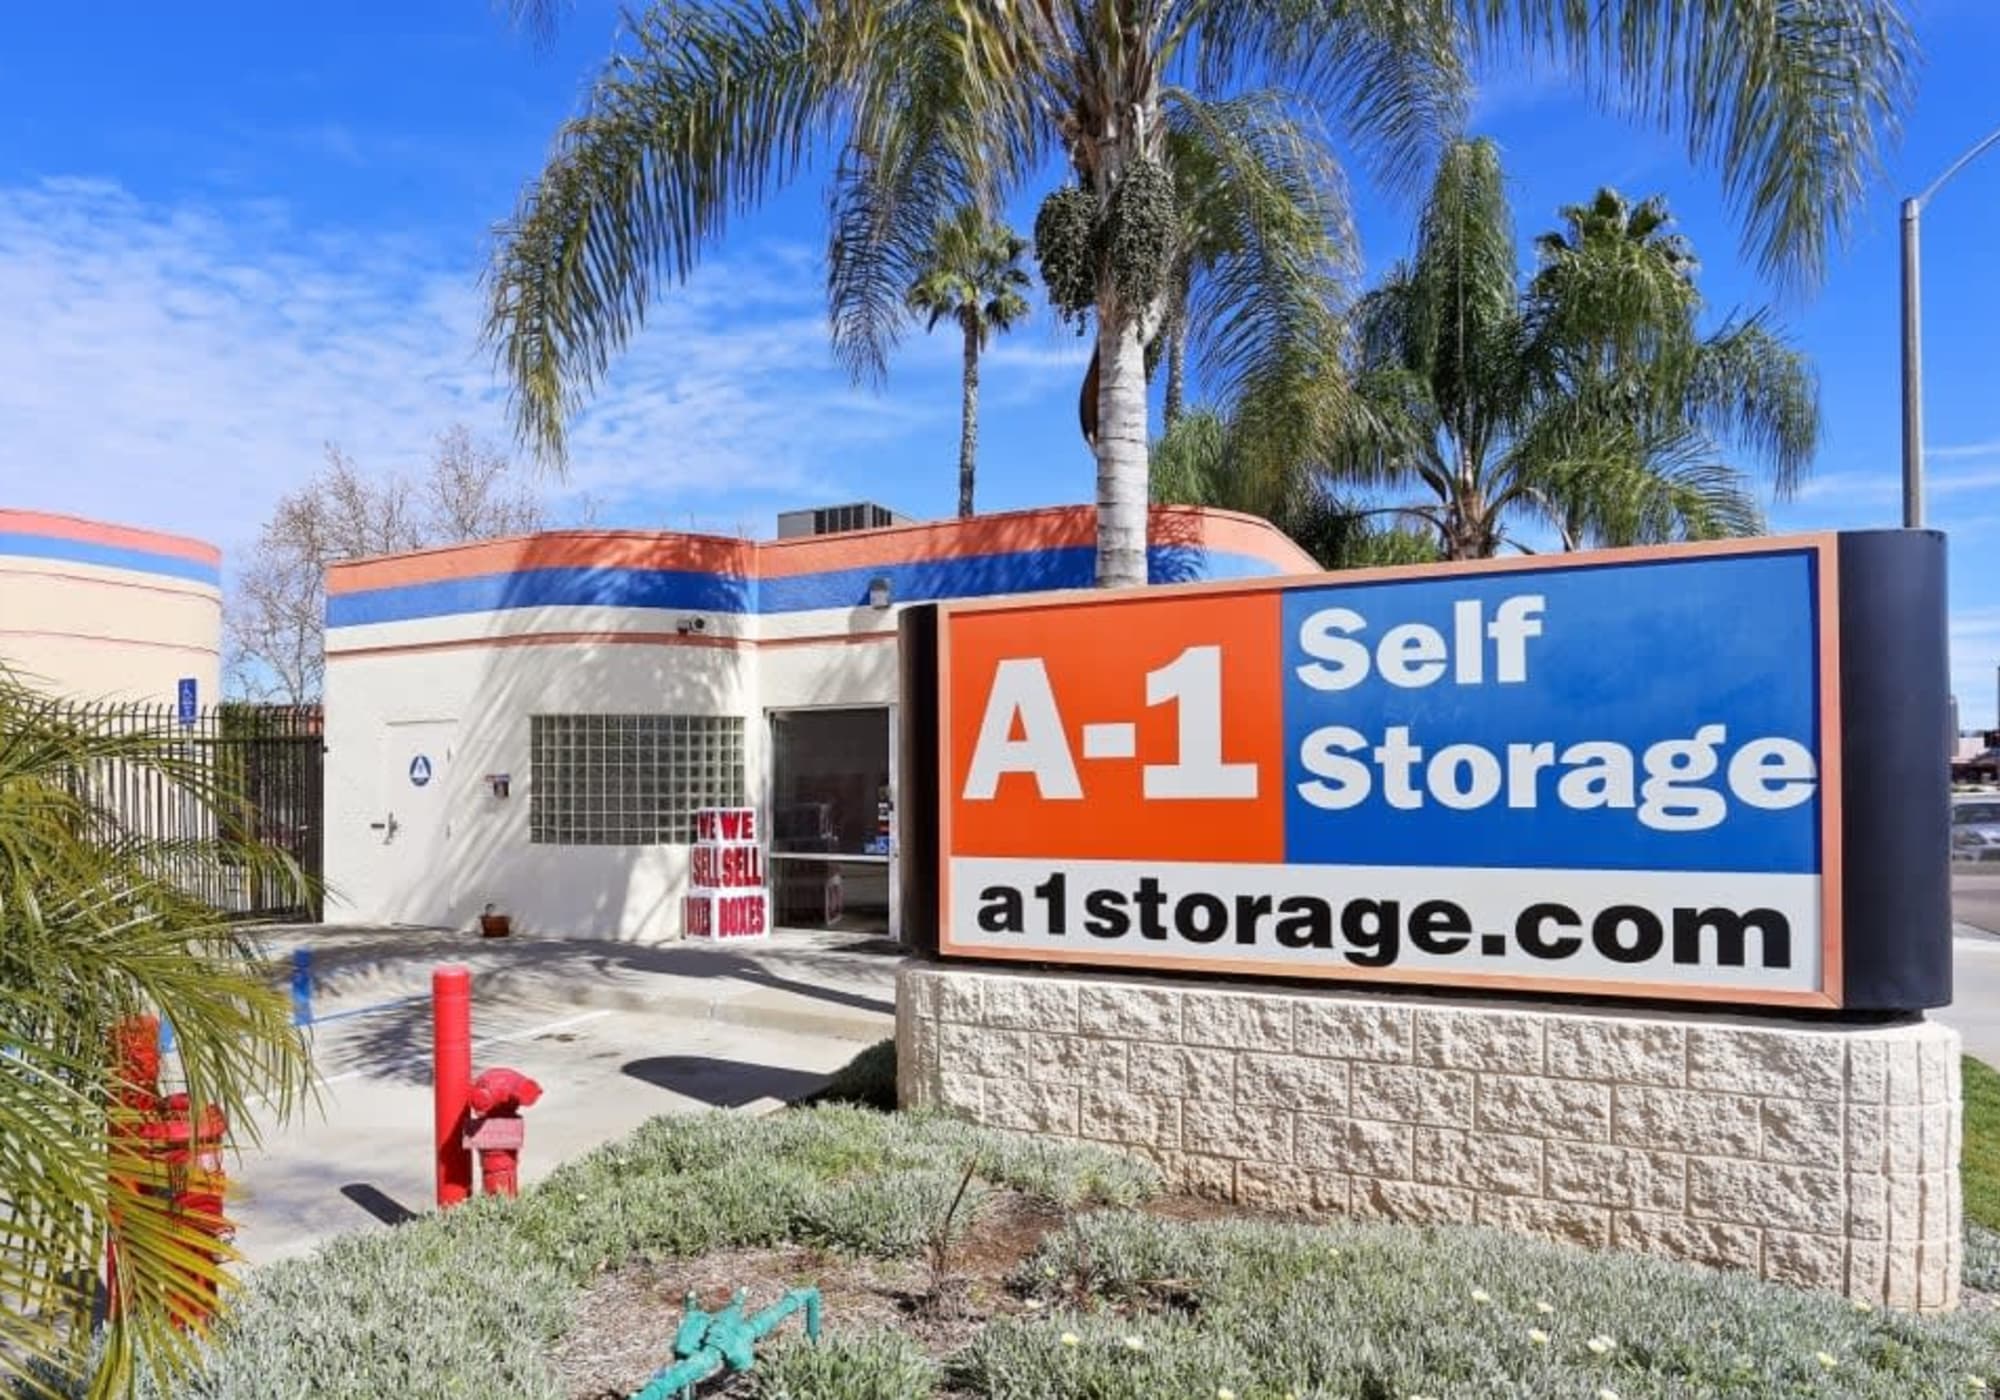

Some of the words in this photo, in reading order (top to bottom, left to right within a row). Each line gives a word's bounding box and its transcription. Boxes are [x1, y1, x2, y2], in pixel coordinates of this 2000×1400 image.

[1297, 595, 1545, 690] Self
[962, 645, 1258, 800] A-1
[1297, 723, 1816, 831] Storage
[720, 811, 754, 840] WE
[722, 846, 761, 887] SELL
[719, 896, 764, 936] BOXES
[976, 872, 1791, 968] a1storage.com
